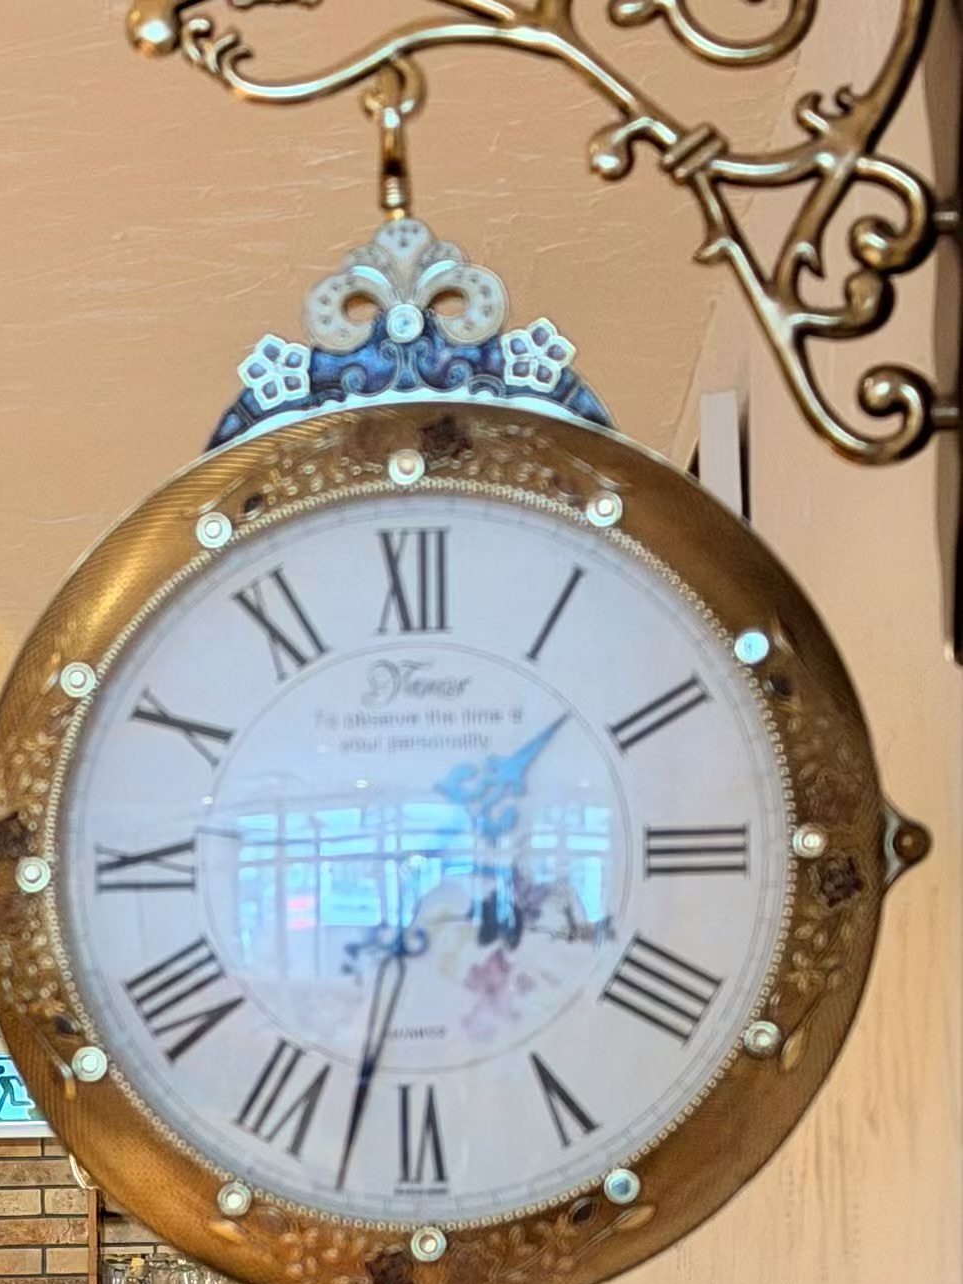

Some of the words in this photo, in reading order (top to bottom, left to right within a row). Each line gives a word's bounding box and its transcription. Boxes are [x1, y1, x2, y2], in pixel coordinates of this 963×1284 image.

[375, 526, 453, 635] XII
[232, 562, 331, 684] XI
[129, 684, 237, 766] X
[608, 674, 713, 756] II
[644, 823, 749, 880] III
